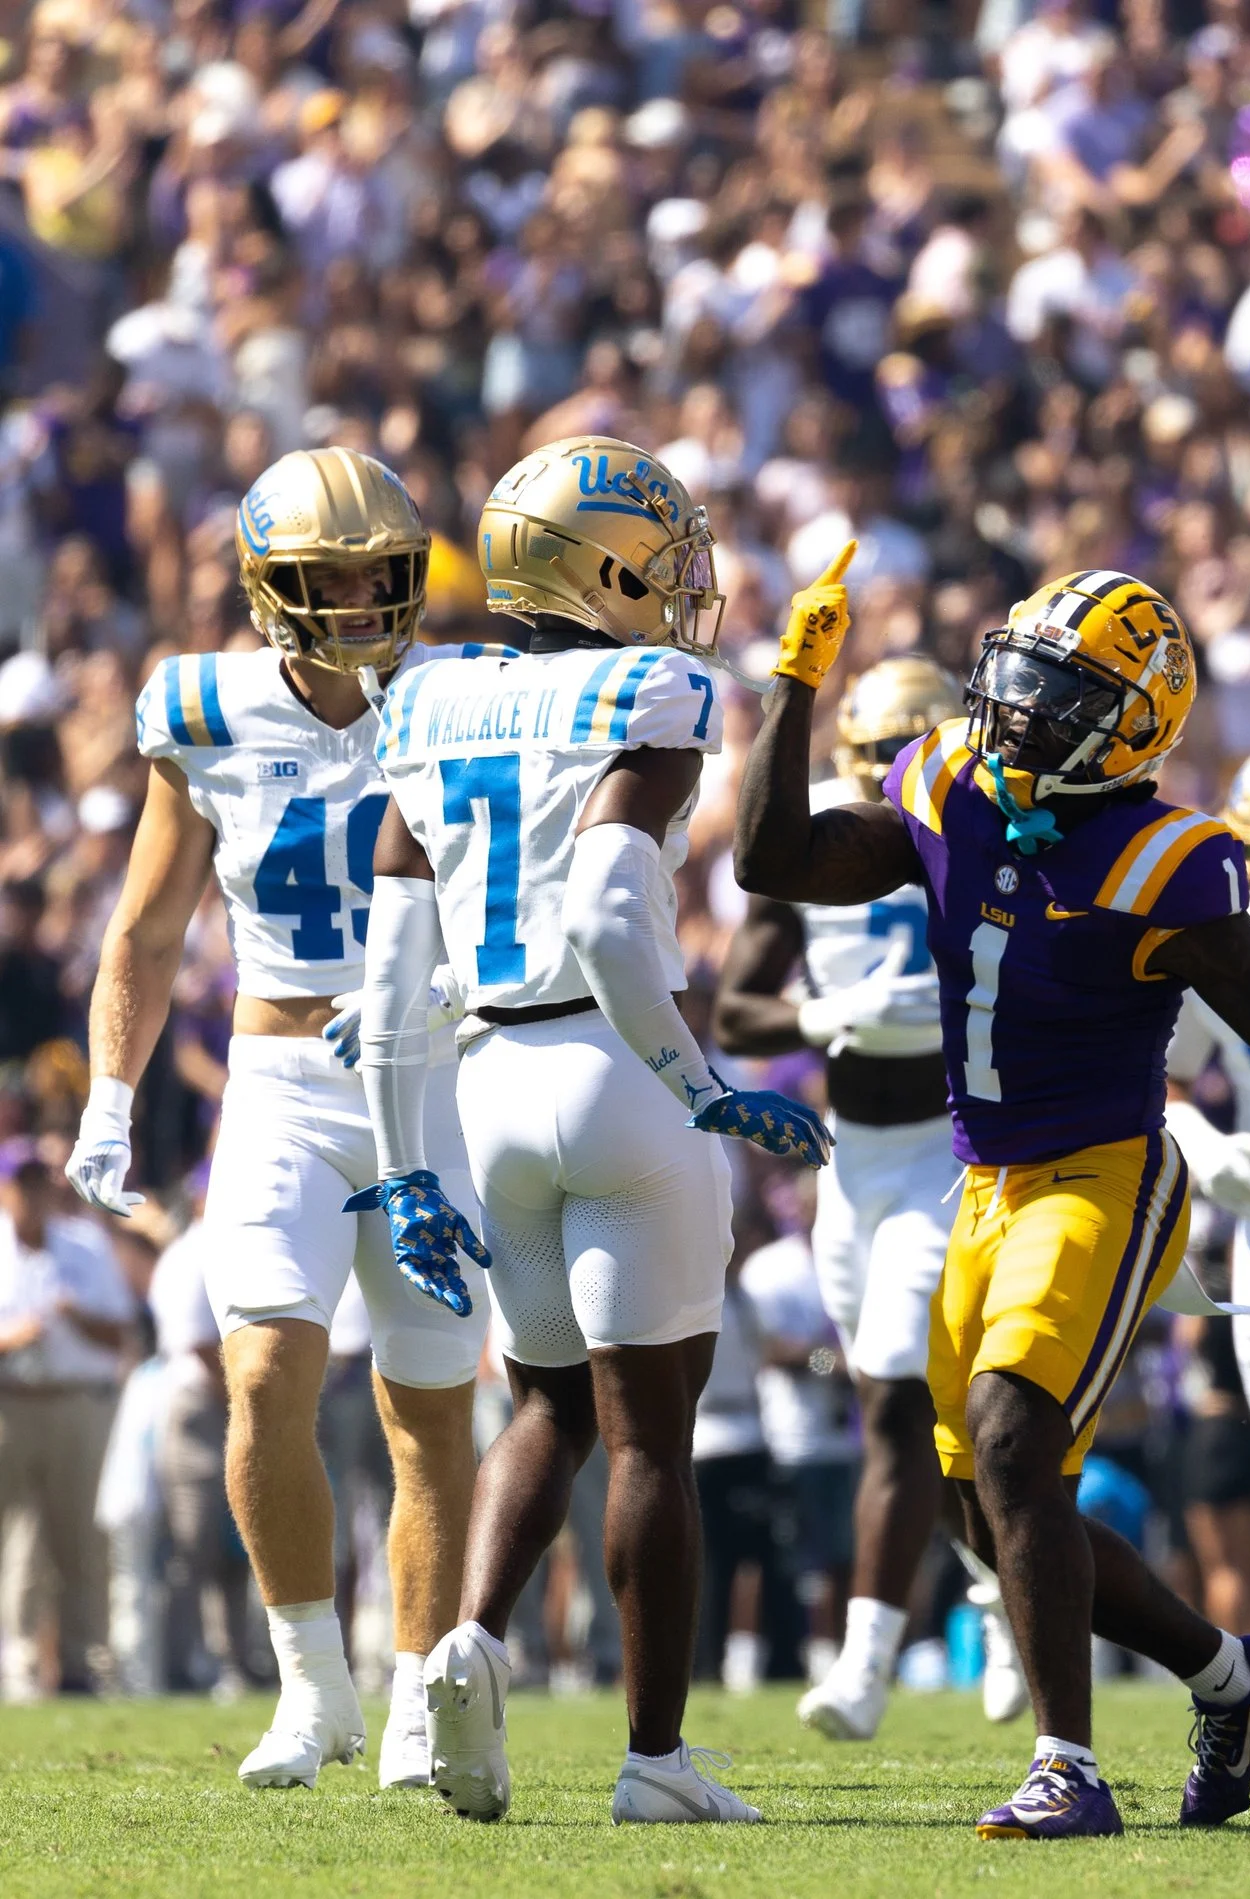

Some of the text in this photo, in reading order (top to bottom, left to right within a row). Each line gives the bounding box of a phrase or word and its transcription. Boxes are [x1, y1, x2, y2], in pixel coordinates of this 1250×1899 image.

[572, 456, 676, 510] Ucla
[1120, 603, 1180, 651] LS
[427, 688, 558, 747] WALLACE II
[687, 673, 713, 740] 7
[439, 754, 526, 986] 7
[1222, 857, 1241, 914] 1
[980, 901, 1015, 928] LSU
[963, 921, 1009, 1103] 1
[645, 1046, 680, 1073] Ucla
